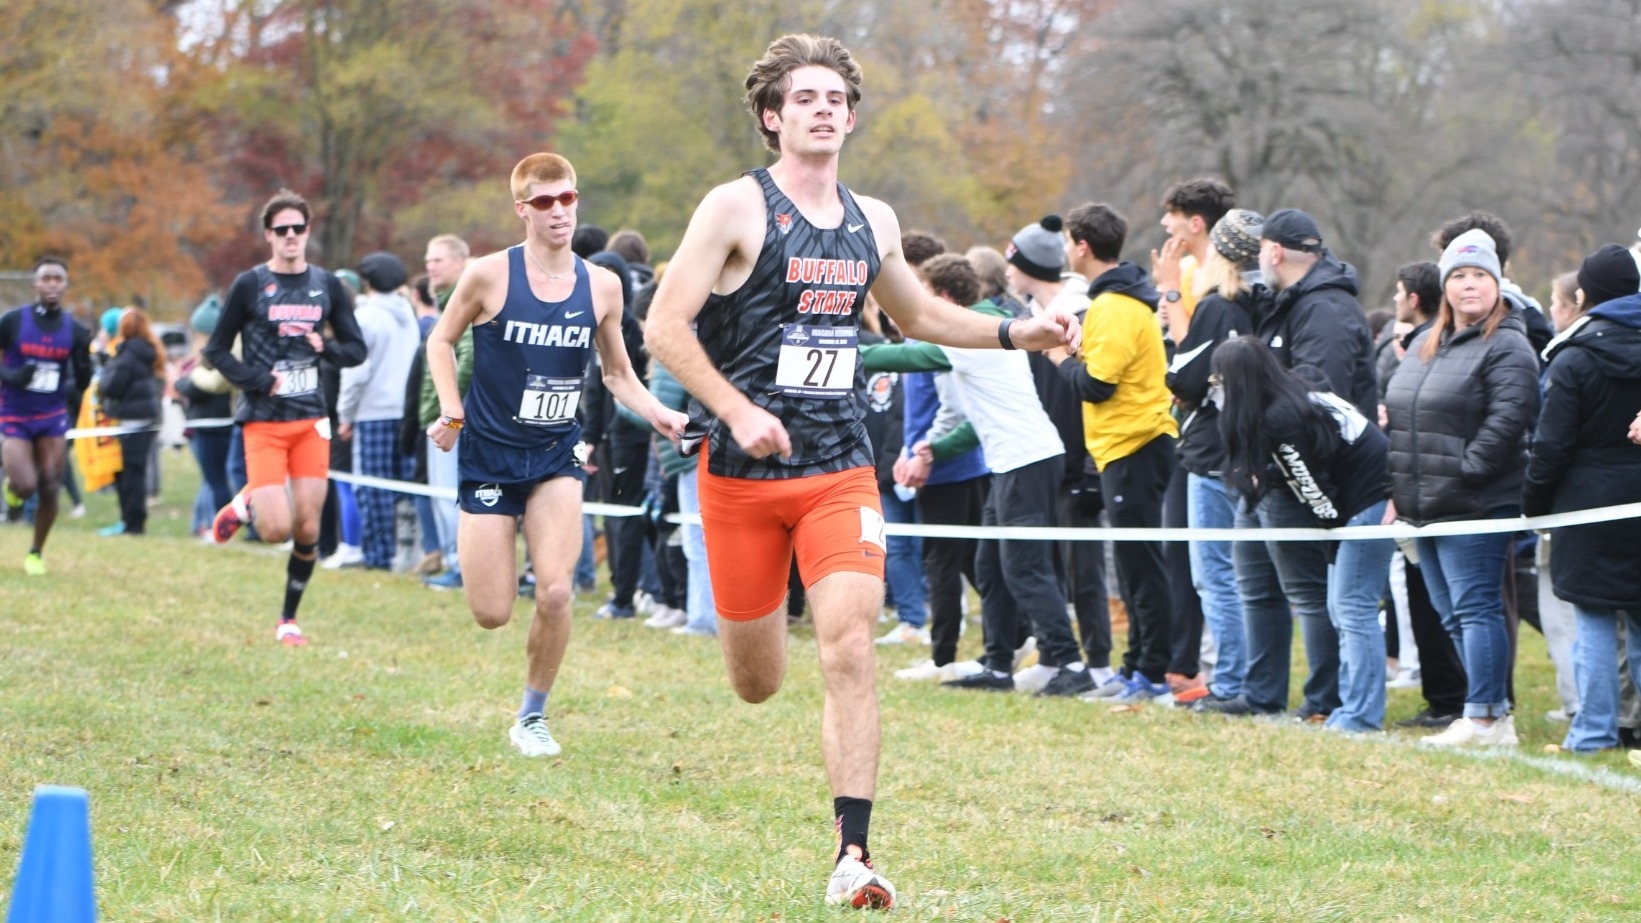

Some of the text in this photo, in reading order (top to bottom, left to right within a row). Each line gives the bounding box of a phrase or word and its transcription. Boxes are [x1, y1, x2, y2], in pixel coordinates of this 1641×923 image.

[785, 257, 868, 286] BUFFALO
[797, 289, 857, 316] STATE
[503, 320, 591, 349] ITHACA
[287, 369, 307, 392] 30
[802, 349, 838, 387] 27
[534, 393, 570, 420] 101
